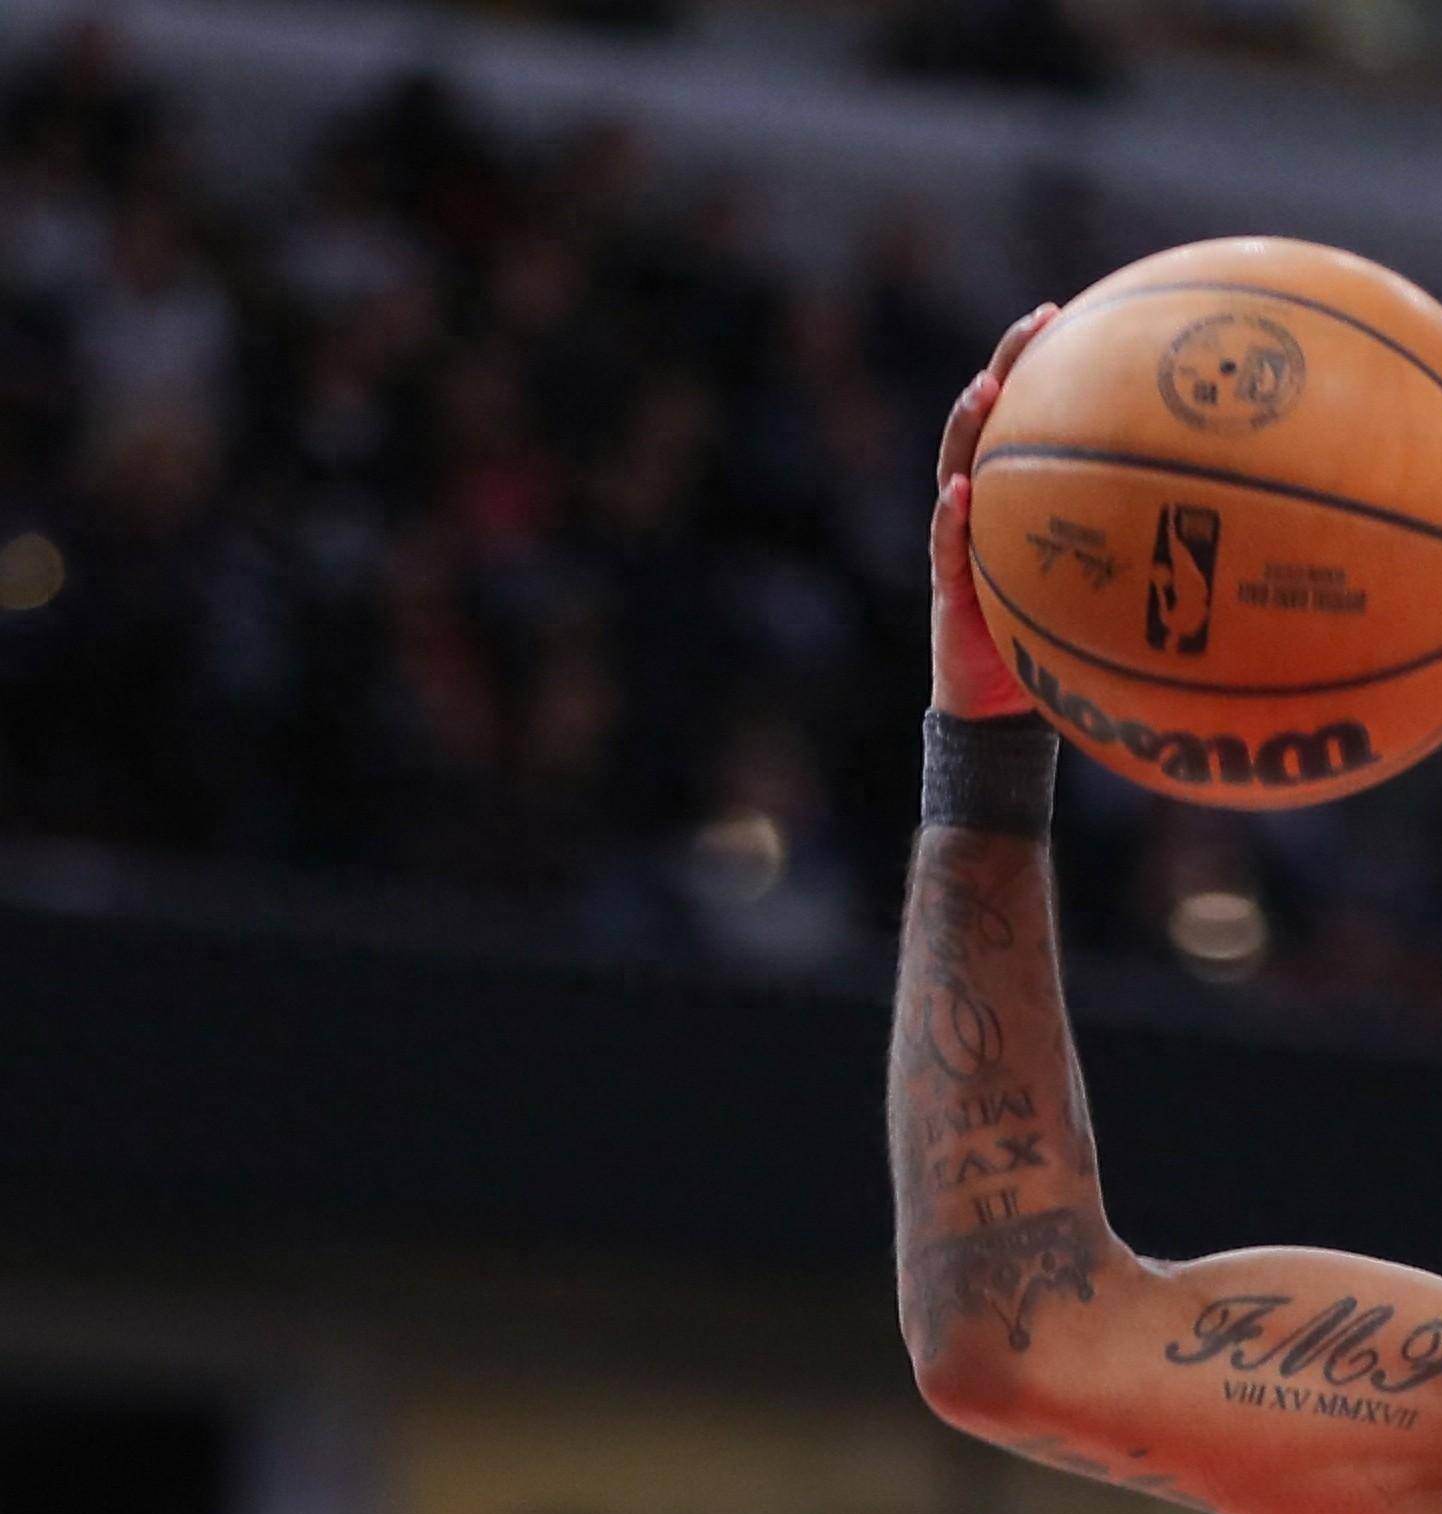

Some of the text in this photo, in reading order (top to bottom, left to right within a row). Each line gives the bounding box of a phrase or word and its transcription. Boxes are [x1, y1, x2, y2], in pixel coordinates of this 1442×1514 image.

[1223, 1380, 1420, 1431] VIII XV MMXVII
